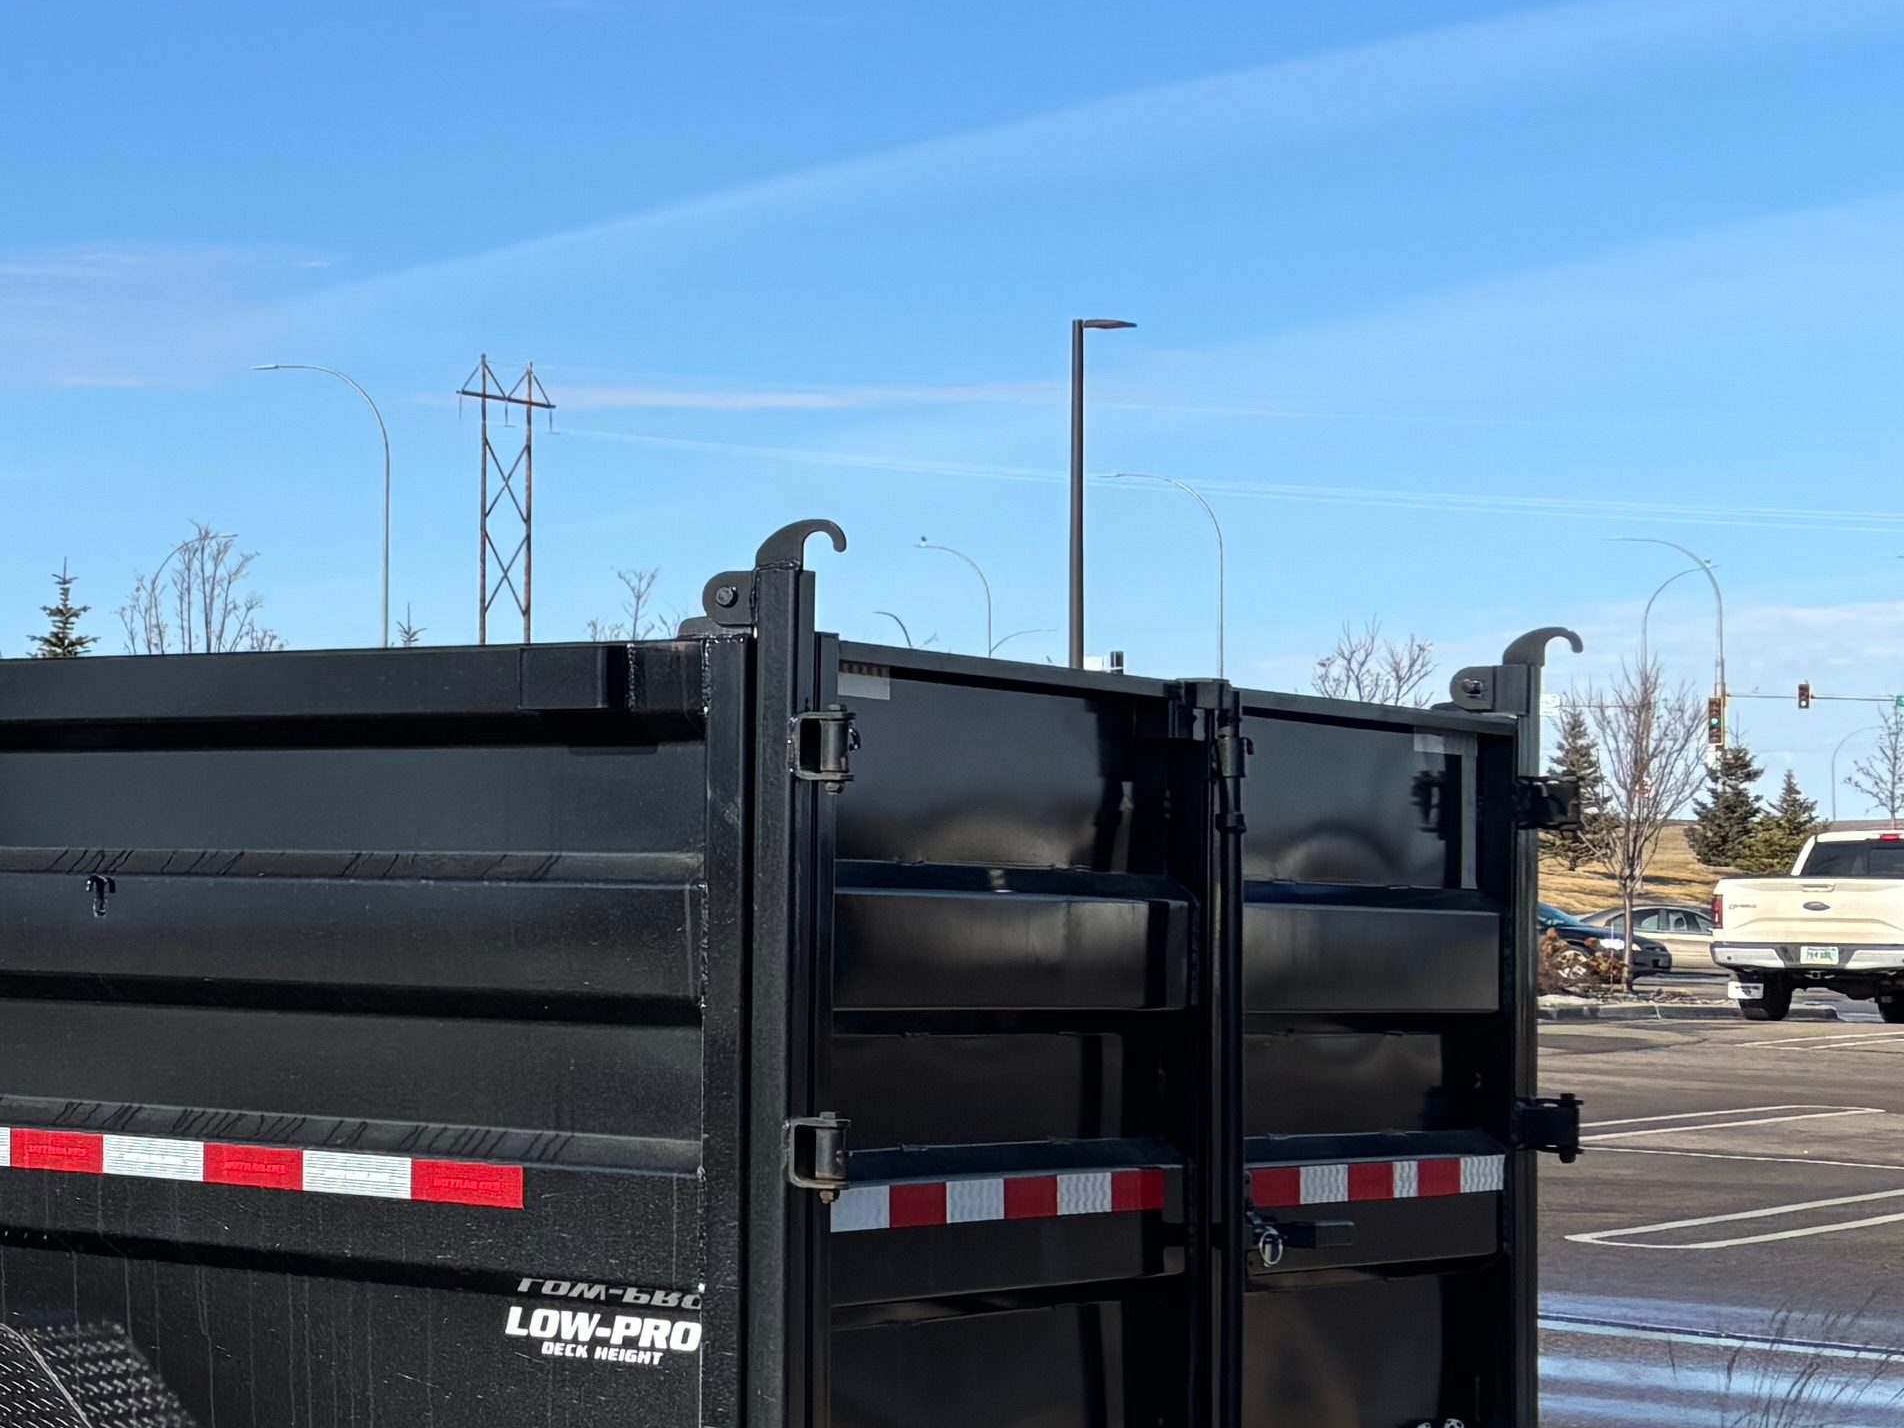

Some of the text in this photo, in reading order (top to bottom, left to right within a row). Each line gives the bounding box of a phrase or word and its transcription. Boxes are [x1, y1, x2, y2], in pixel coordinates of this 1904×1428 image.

[505, 1305, 703, 1352] LOW-PRO
[542, 1341, 665, 1365] DECK HEIGHT
